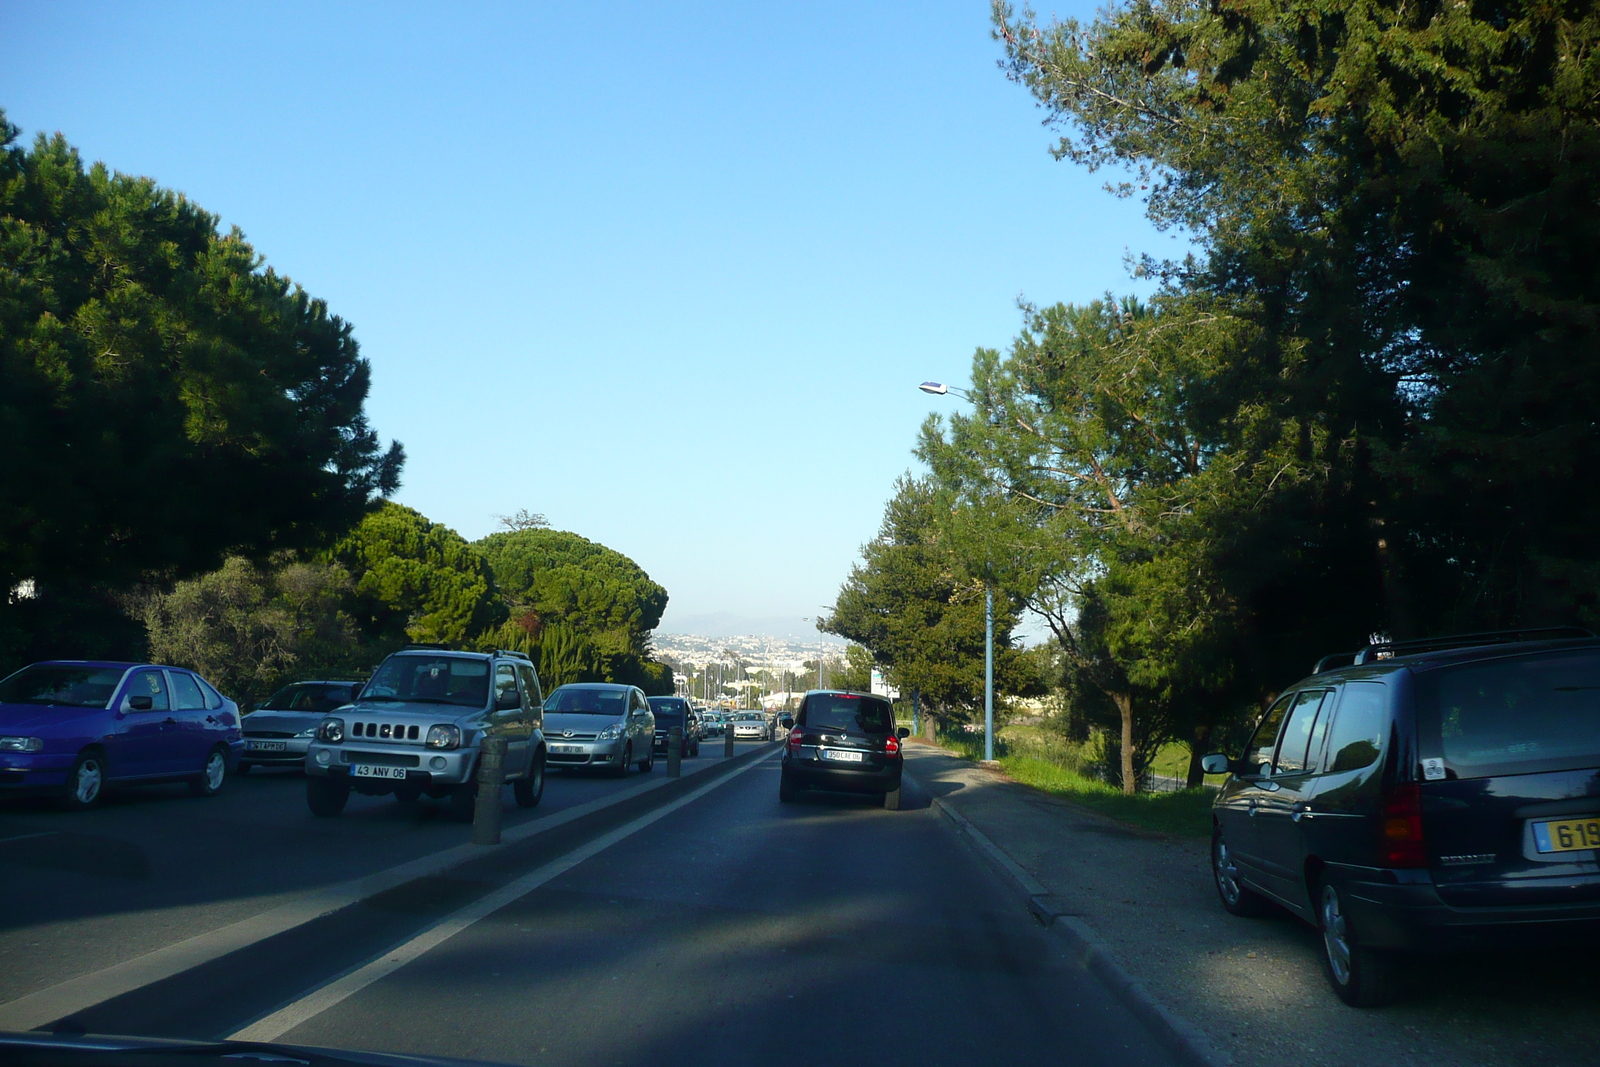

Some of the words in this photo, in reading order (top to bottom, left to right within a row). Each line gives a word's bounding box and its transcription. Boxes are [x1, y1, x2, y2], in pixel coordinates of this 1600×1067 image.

[828, 751, 840, 759] 350
[357, 766, 369, 775] 43
[373, 767, 389, 777] ANV
[393, 768, 404, 778] 06
[1558, 822, 1600, 848] 619
